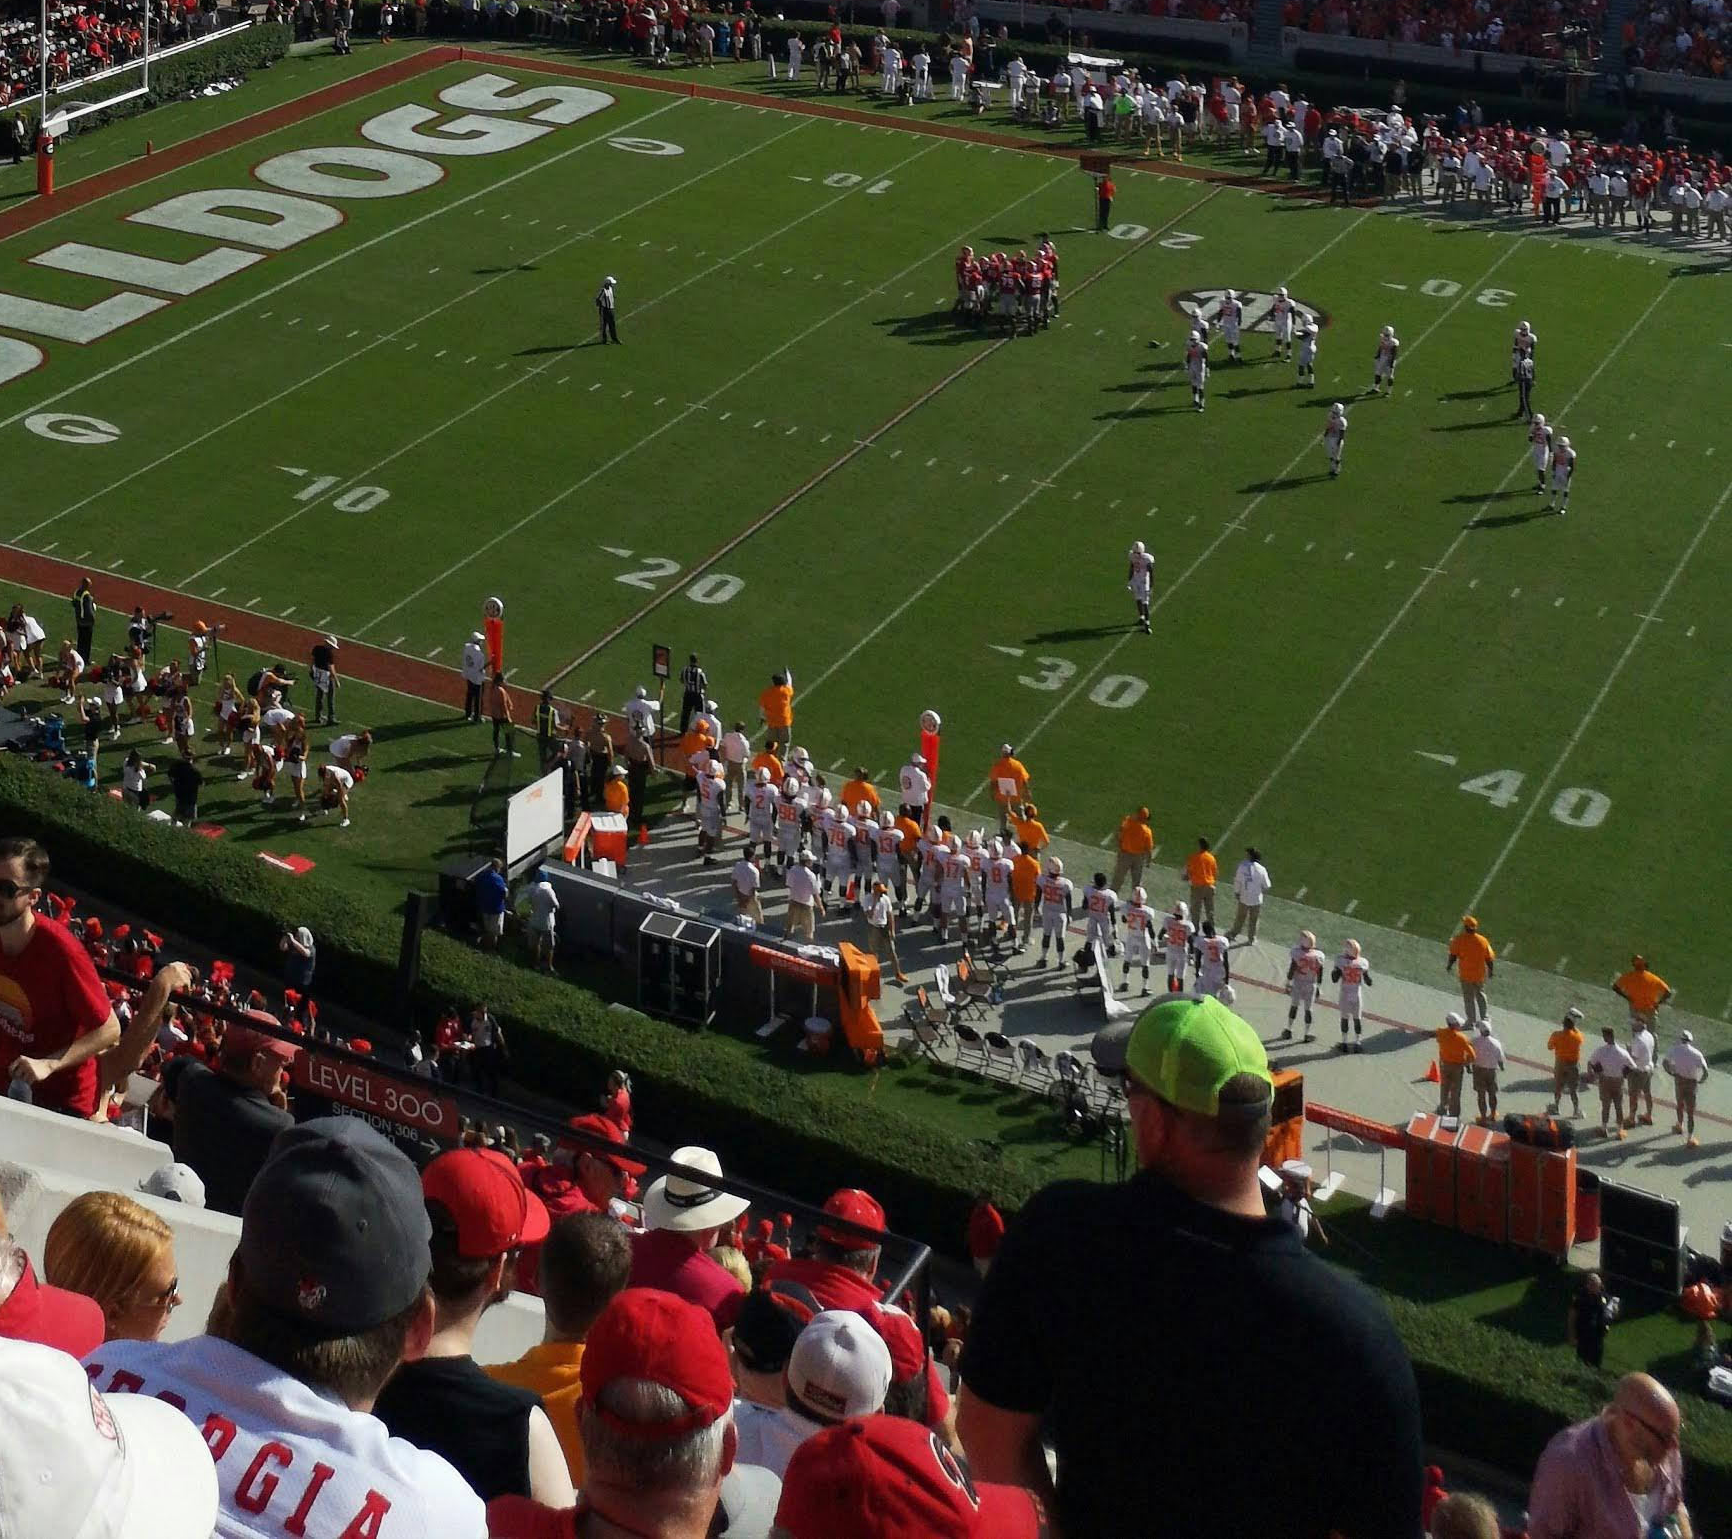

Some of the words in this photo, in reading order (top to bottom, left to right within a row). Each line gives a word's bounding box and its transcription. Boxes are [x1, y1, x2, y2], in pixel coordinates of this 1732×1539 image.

[24, 412, 122, 444] G
[293, 475, 391, 514] 10
[614, 556, 746, 604] 20
[1018, 655, 1151, 709] 30
[1458, 768, 1612, 828] 40
[308, 1061, 378, 1106] LEVEL
[384, 1087, 443, 1125] 300
[331, 1101, 393, 1131] SECTION
[396, 1124, 418, 1142] 306
